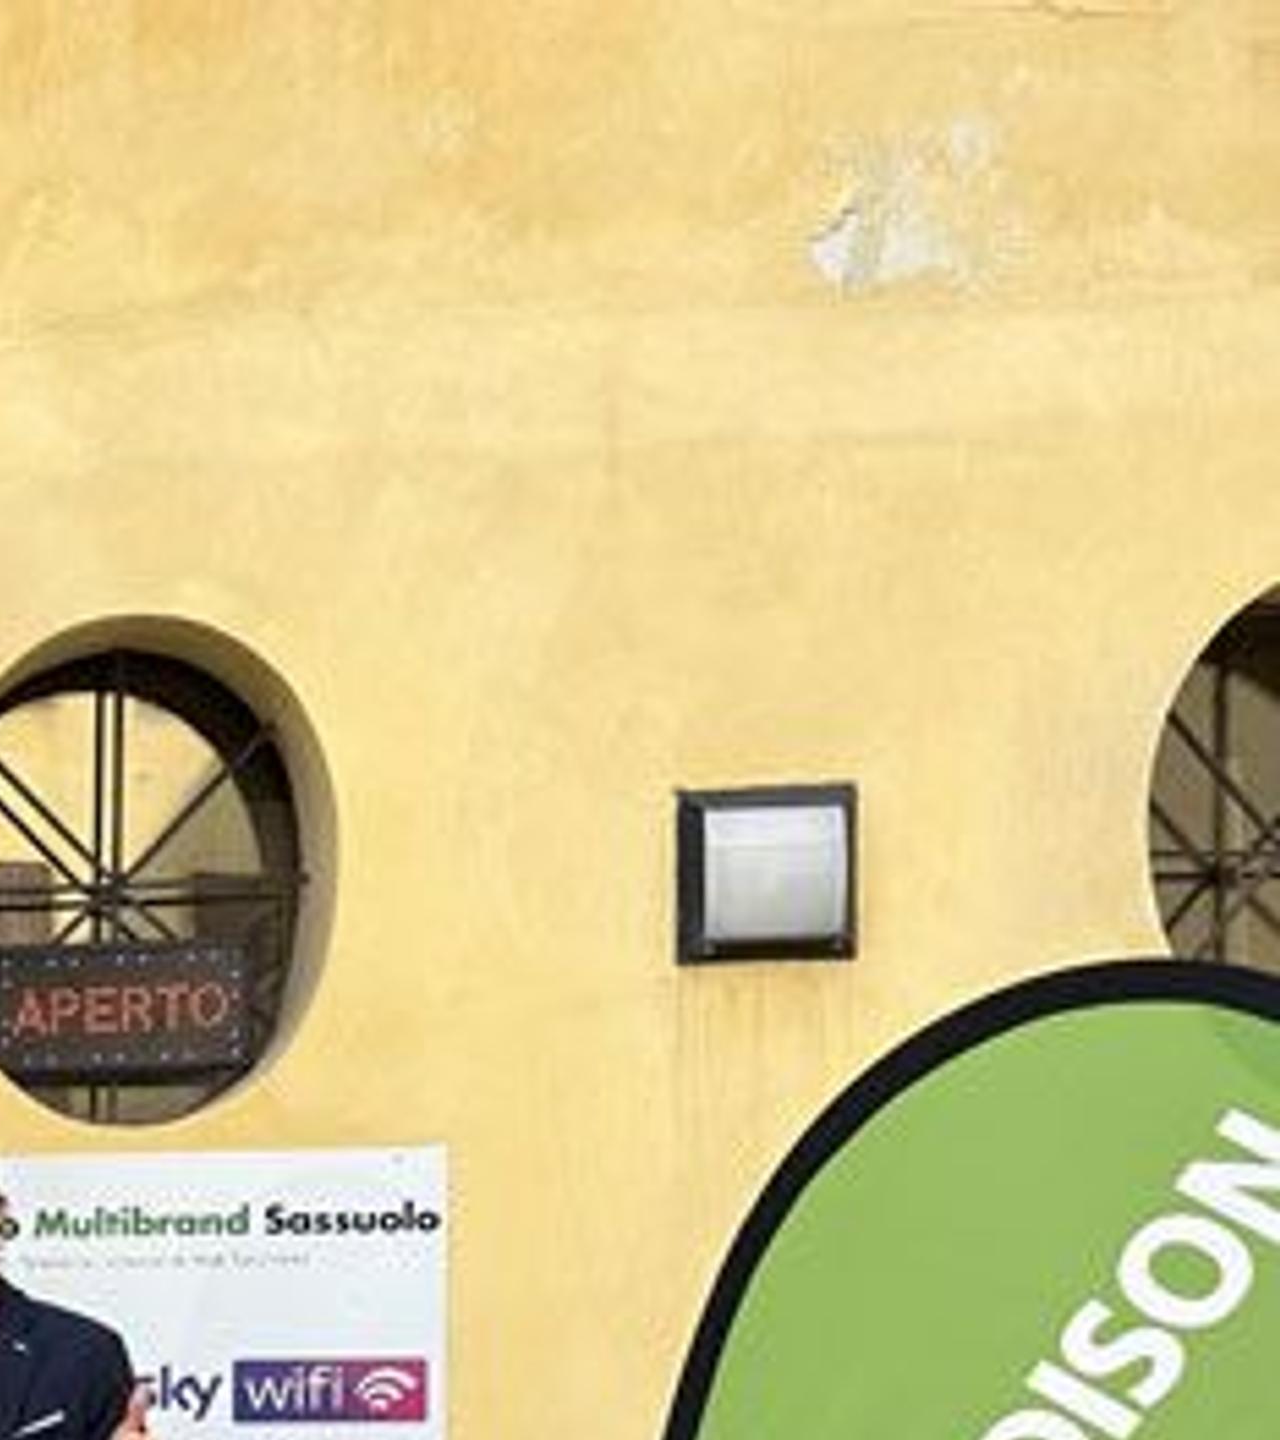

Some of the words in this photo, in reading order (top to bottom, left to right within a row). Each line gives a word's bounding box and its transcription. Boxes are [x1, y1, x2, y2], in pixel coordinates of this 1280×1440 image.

[13, 982, 228, 1036] APERTO
[34, 1205, 252, 1238] Multibrand
[264, 1201, 441, 1235] Sassuolo
[244, 1366, 343, 1412] wifi
